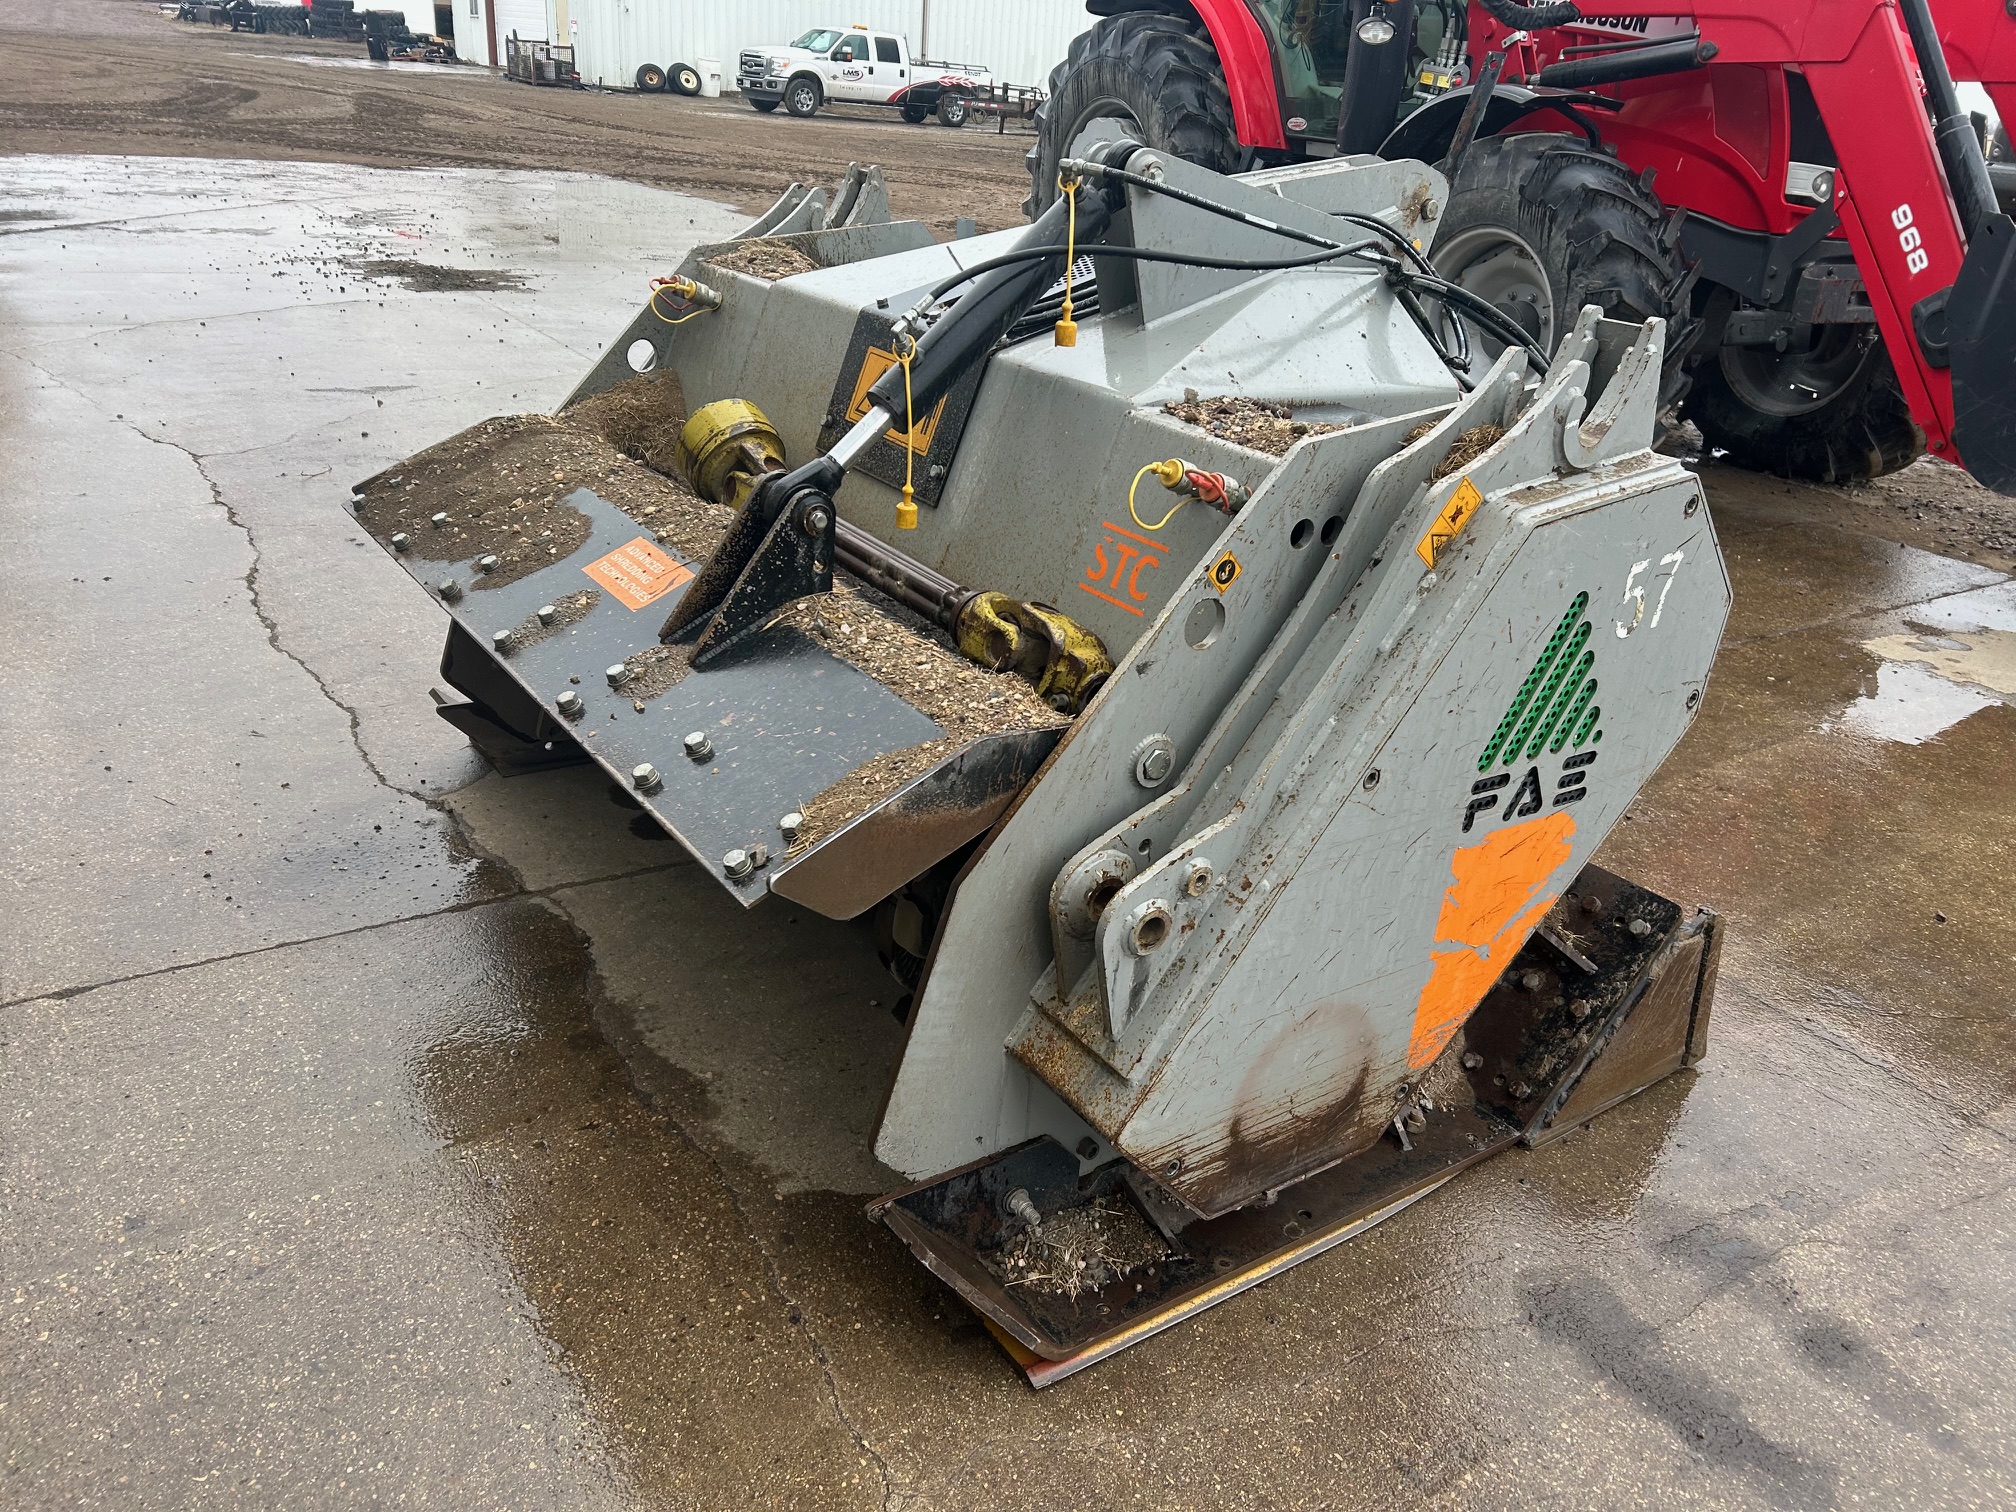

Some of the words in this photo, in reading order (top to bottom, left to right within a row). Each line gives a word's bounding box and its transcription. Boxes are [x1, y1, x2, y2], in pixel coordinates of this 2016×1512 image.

[1891, 203, 1929, 275] 968
[597, 560, 650, 603] TECHNOLOGIES
[610, 553, 654, 585] SHREDDING
[624, 545, 665, 574] ADVANCED
[1085, 536, 1160, 601] STC
[1615, 549, 1684, 639] 57
[1462, 750, 1597, 834] FAE
